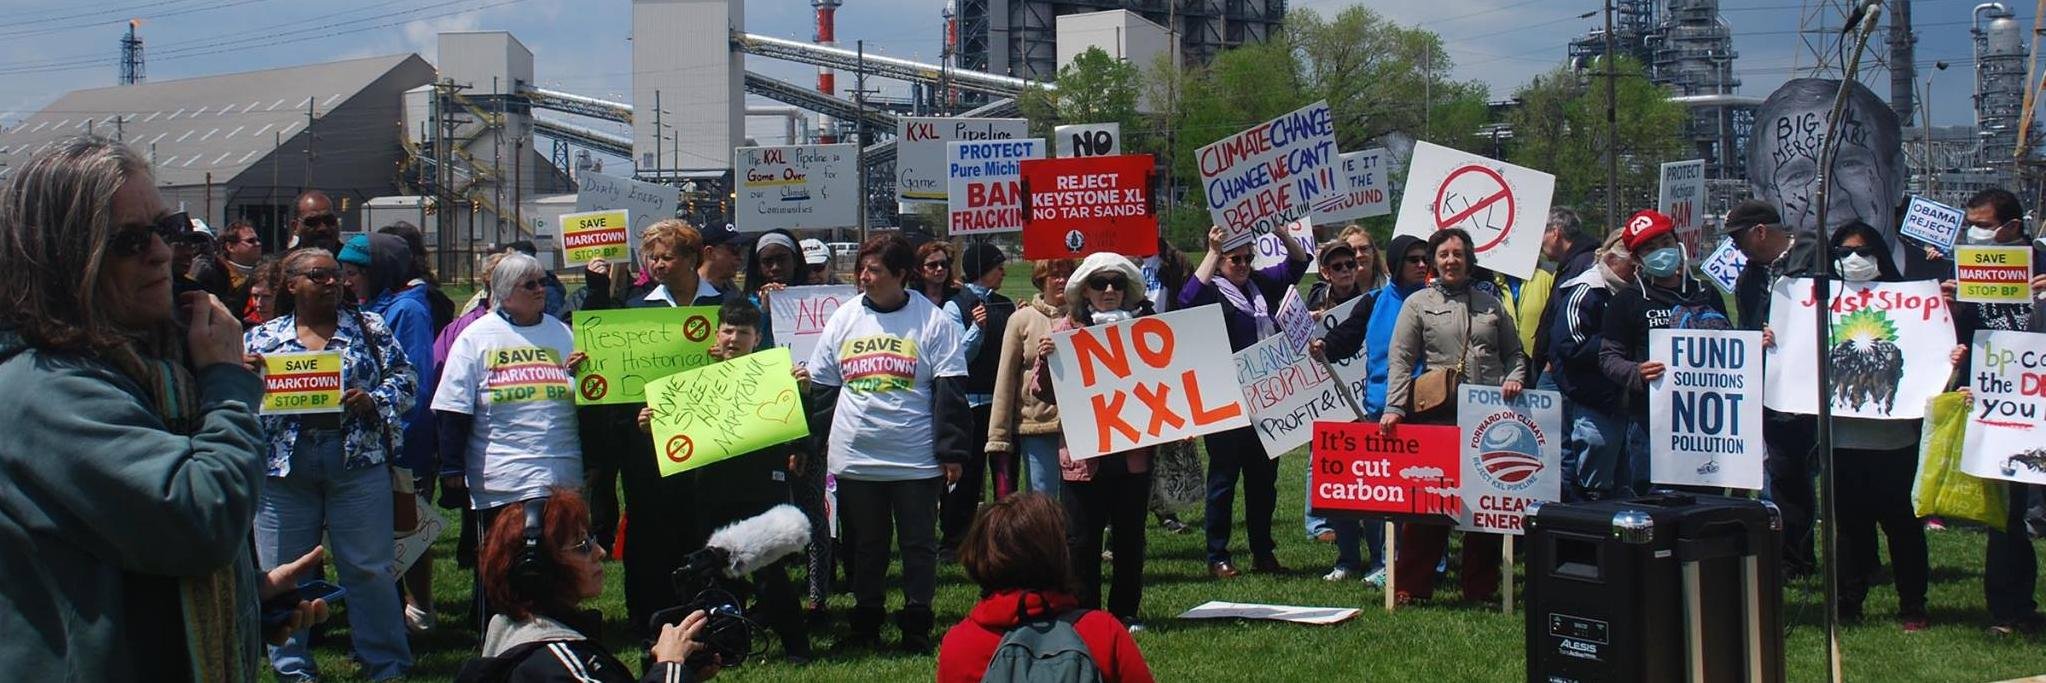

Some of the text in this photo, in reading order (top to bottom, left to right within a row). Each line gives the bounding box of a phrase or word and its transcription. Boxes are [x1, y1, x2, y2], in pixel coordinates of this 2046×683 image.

[907, 122, 1012, 141] KXL Pipeline
[1777, 112, 1819, 139] BIG
[959, 142, 1033, 159] PROTECT
[1072, 130, 1113, 156] NO
[1200, 124, 1272, 177] CLIMATE
[763, 150, 786, 166] KXL
[796, 147, 827, 169] Pipeline
[1364, 155, 1378, 169] IT
[747, 168, 774, 182] Game
[783, 168, 806, 181] Over
[901, 168, 937, 191] Game
[951, 161, 1019, 178] Pure Michi
[1351, 173, 1373, 187] THE
[1667, 163, 1701, 181] PROTECT
[1056, 173, 1118, 190] REJECT
[1209, 161, 1271, 210] CHANGE
[1267, 154, 1290, 183] WE
[584, 178, 664, 209] Dirty Energy
[967, 181, 1022, 208] BAN
[1032, 188, 1145, 207] KEYSTONE XL
[758, 201, 813, 214] Communities
[1033, 204, 1146, 220] NO TAR SANDS
[1223, 183, 1292, 235] BELIEVE
[1443, 191, 1502, 231] KXL
[1671, 200, 1692, 228] BAN
[1913, 203, 1957, 225] OBAMA
[580, 218, 607, 229] SAVE
[1250, 220, 1270, 241] NO
[1634, 218, 1648, 232] M
[1909, 215, 1953, 236] REJECT
[565, 231, 625, 246] MARKTOWN
[575, 247, 618, 260] STOP BP
[1975, 254, 2007, 263] SAVE
[1719, 256, 1744, 286] KX
[1959, 269, 2027, 281] MARKTOWN
[1968, 286, 2018, 296] STOP BP
[797, 296, 840, 331] NO
[1281, 303, 1297, 328] KXL
[1646, 309, 1672, 319] CHI
[583, 317, 672, 352] Respect
[1294, 318, 1313, 348] CHANGE
[498, 349, 548, 364] SAVE
[853, 338, 902, 354] SAVE
[1070, 317, 1175, 387] NO
[1671, 336, 1745, 369] FUND
[286, 360, 318, 371] SAVE
[622, 350, 710, 371] Historical
[843, 357, 916, 376] MARKTOWN
[266, 376, 338, 390] MARKTOWN
[1243, 358, 1331, 414] PEOPLE
[1674, 372, 1744, 389] SOLUTIONS
[1978, 371, 2013, 394] the
[275, 394, 329, 407] STOP BP
[493, 385, 567, 401] STOP BP
[650, 376, 687, 427] HOME
[674, 369, 711, 430] SWEET
[1468, 389, 1552, 410] FORWARD
[714, 358, 778, 455] MARKTOWN
[1091, 369, 1241, 453] KXL
[1260, 397, 1319, 441] PROFIT
[1322, 390, 1335, 411] &
[1672, 391, 1743, 436] NOT
[1980, 399, 2035, 420] you
[1471, 411, 1546, 449] FORWARD ON CLIMATE
[1320, 430, 1420, 454] It's time
[1672, 435, 1744, 454] POLLUTION
[1321, 457, 1391, 478] to cut
[1319, 479, 1405, 503] carbon
[1560, 639, 1597, 653] ALESIS
